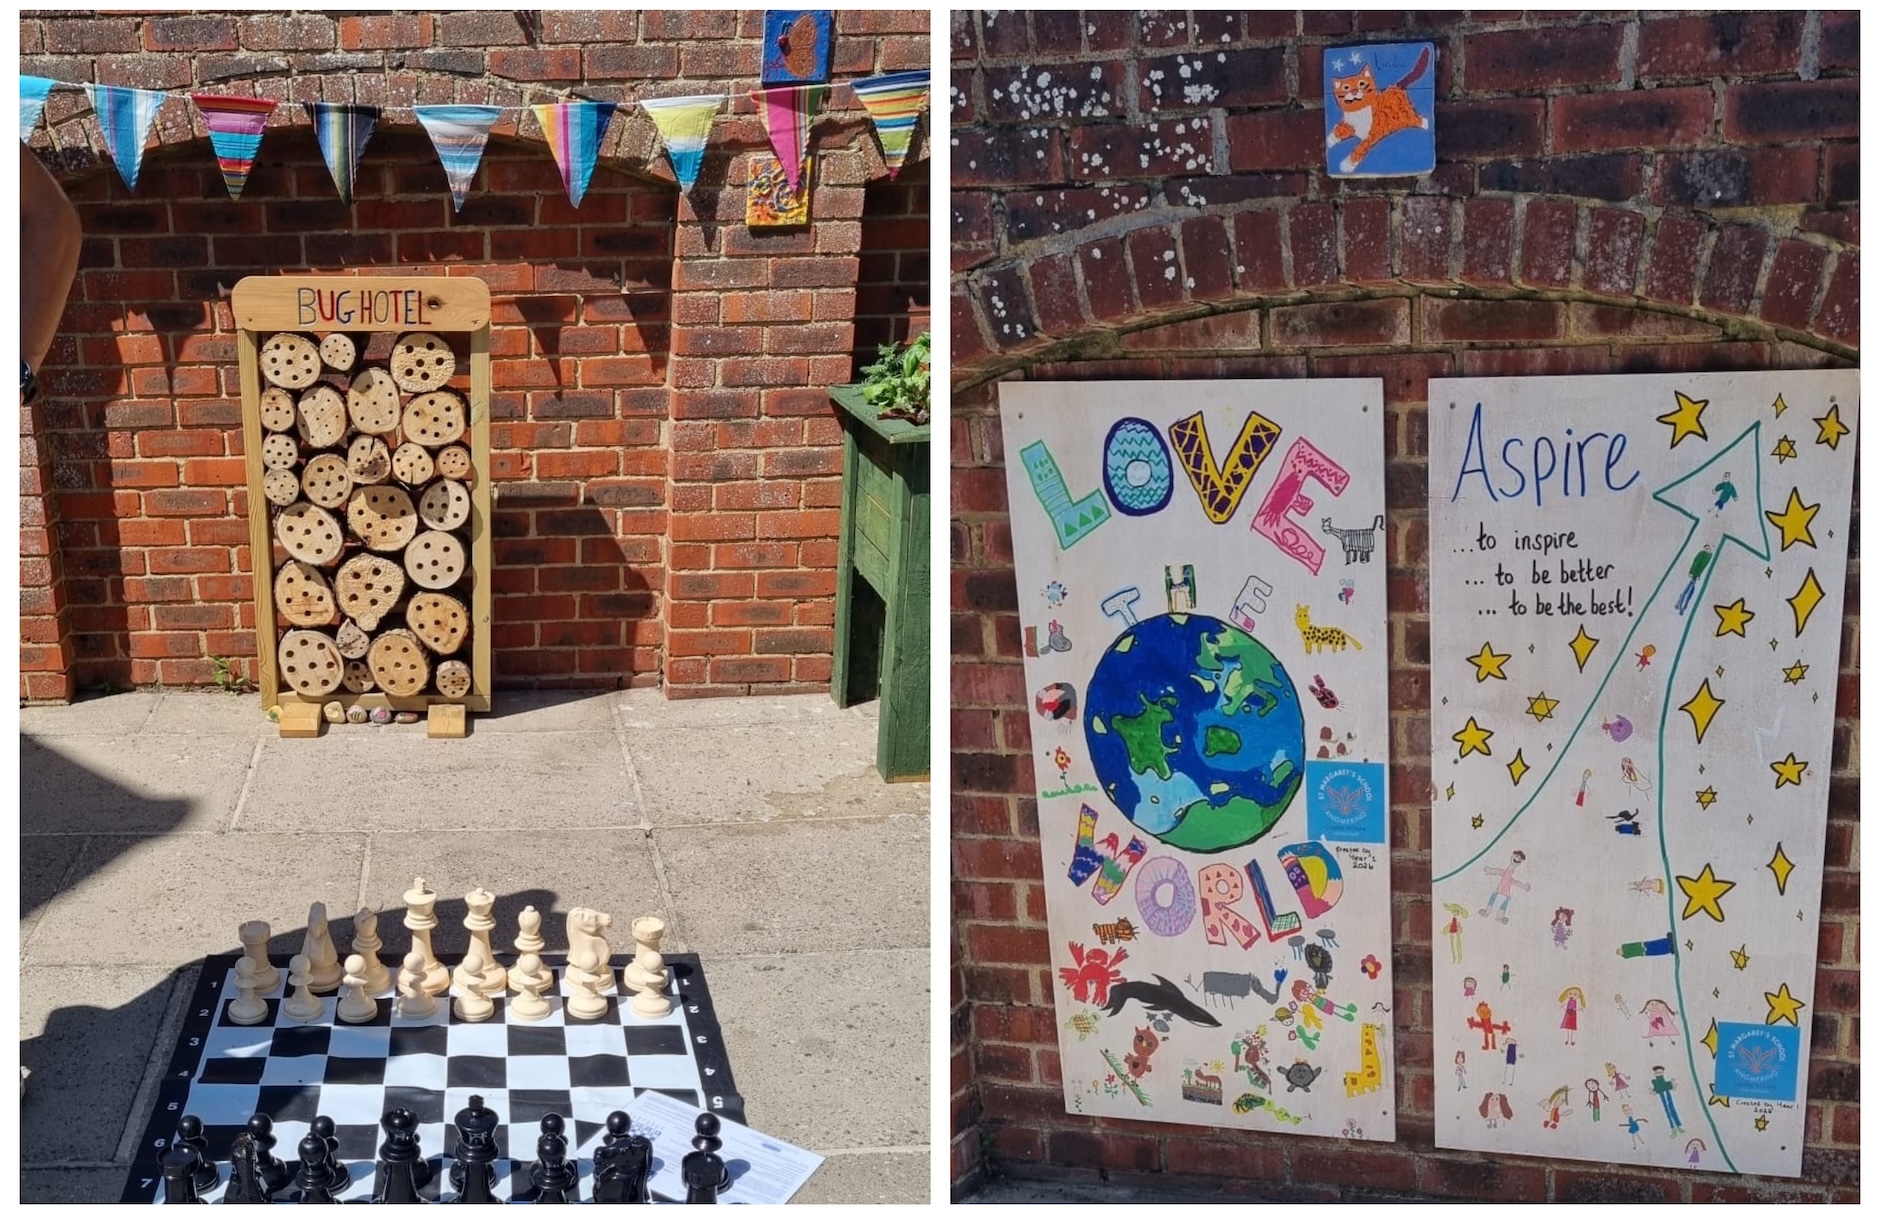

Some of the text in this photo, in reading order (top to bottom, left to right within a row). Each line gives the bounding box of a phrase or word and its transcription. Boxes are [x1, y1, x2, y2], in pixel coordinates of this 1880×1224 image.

[297, 287, 432, 325] BUG HOTEL
[1451, 402, 1639, 507] Aspire
[1019, 410, 1351, 576] LOVE
[1514, 529, 1579, 555] inspire
[1532, 560, 1552, 585] be
[1560, 558, 1615, 585] better
[1101, 564, 1273, 633] THE
[1535, 592, 1554, 617] be
[1557, 591, 1587, 616] the
[1589, 586, 1634, 618] best!
[1356, 774, 1373, 802] SCHOOL
[1067, 803, 1345, 950] WORLD
[199, 1009, 209, 1017] 2
[189, 1037, 200, 1046] 3
[696, 1035, 708, 1044] 3
[1771, 1036, 1787, 1062] SCHOOL
[704, 1067, 715, 1076] 4
[167, 1102, 179, 1111] 5
[712, 1096, 724, 1109] 5
[153, 1138, 166, 1147] 6
[140, 1178, 153, 1188] 7
